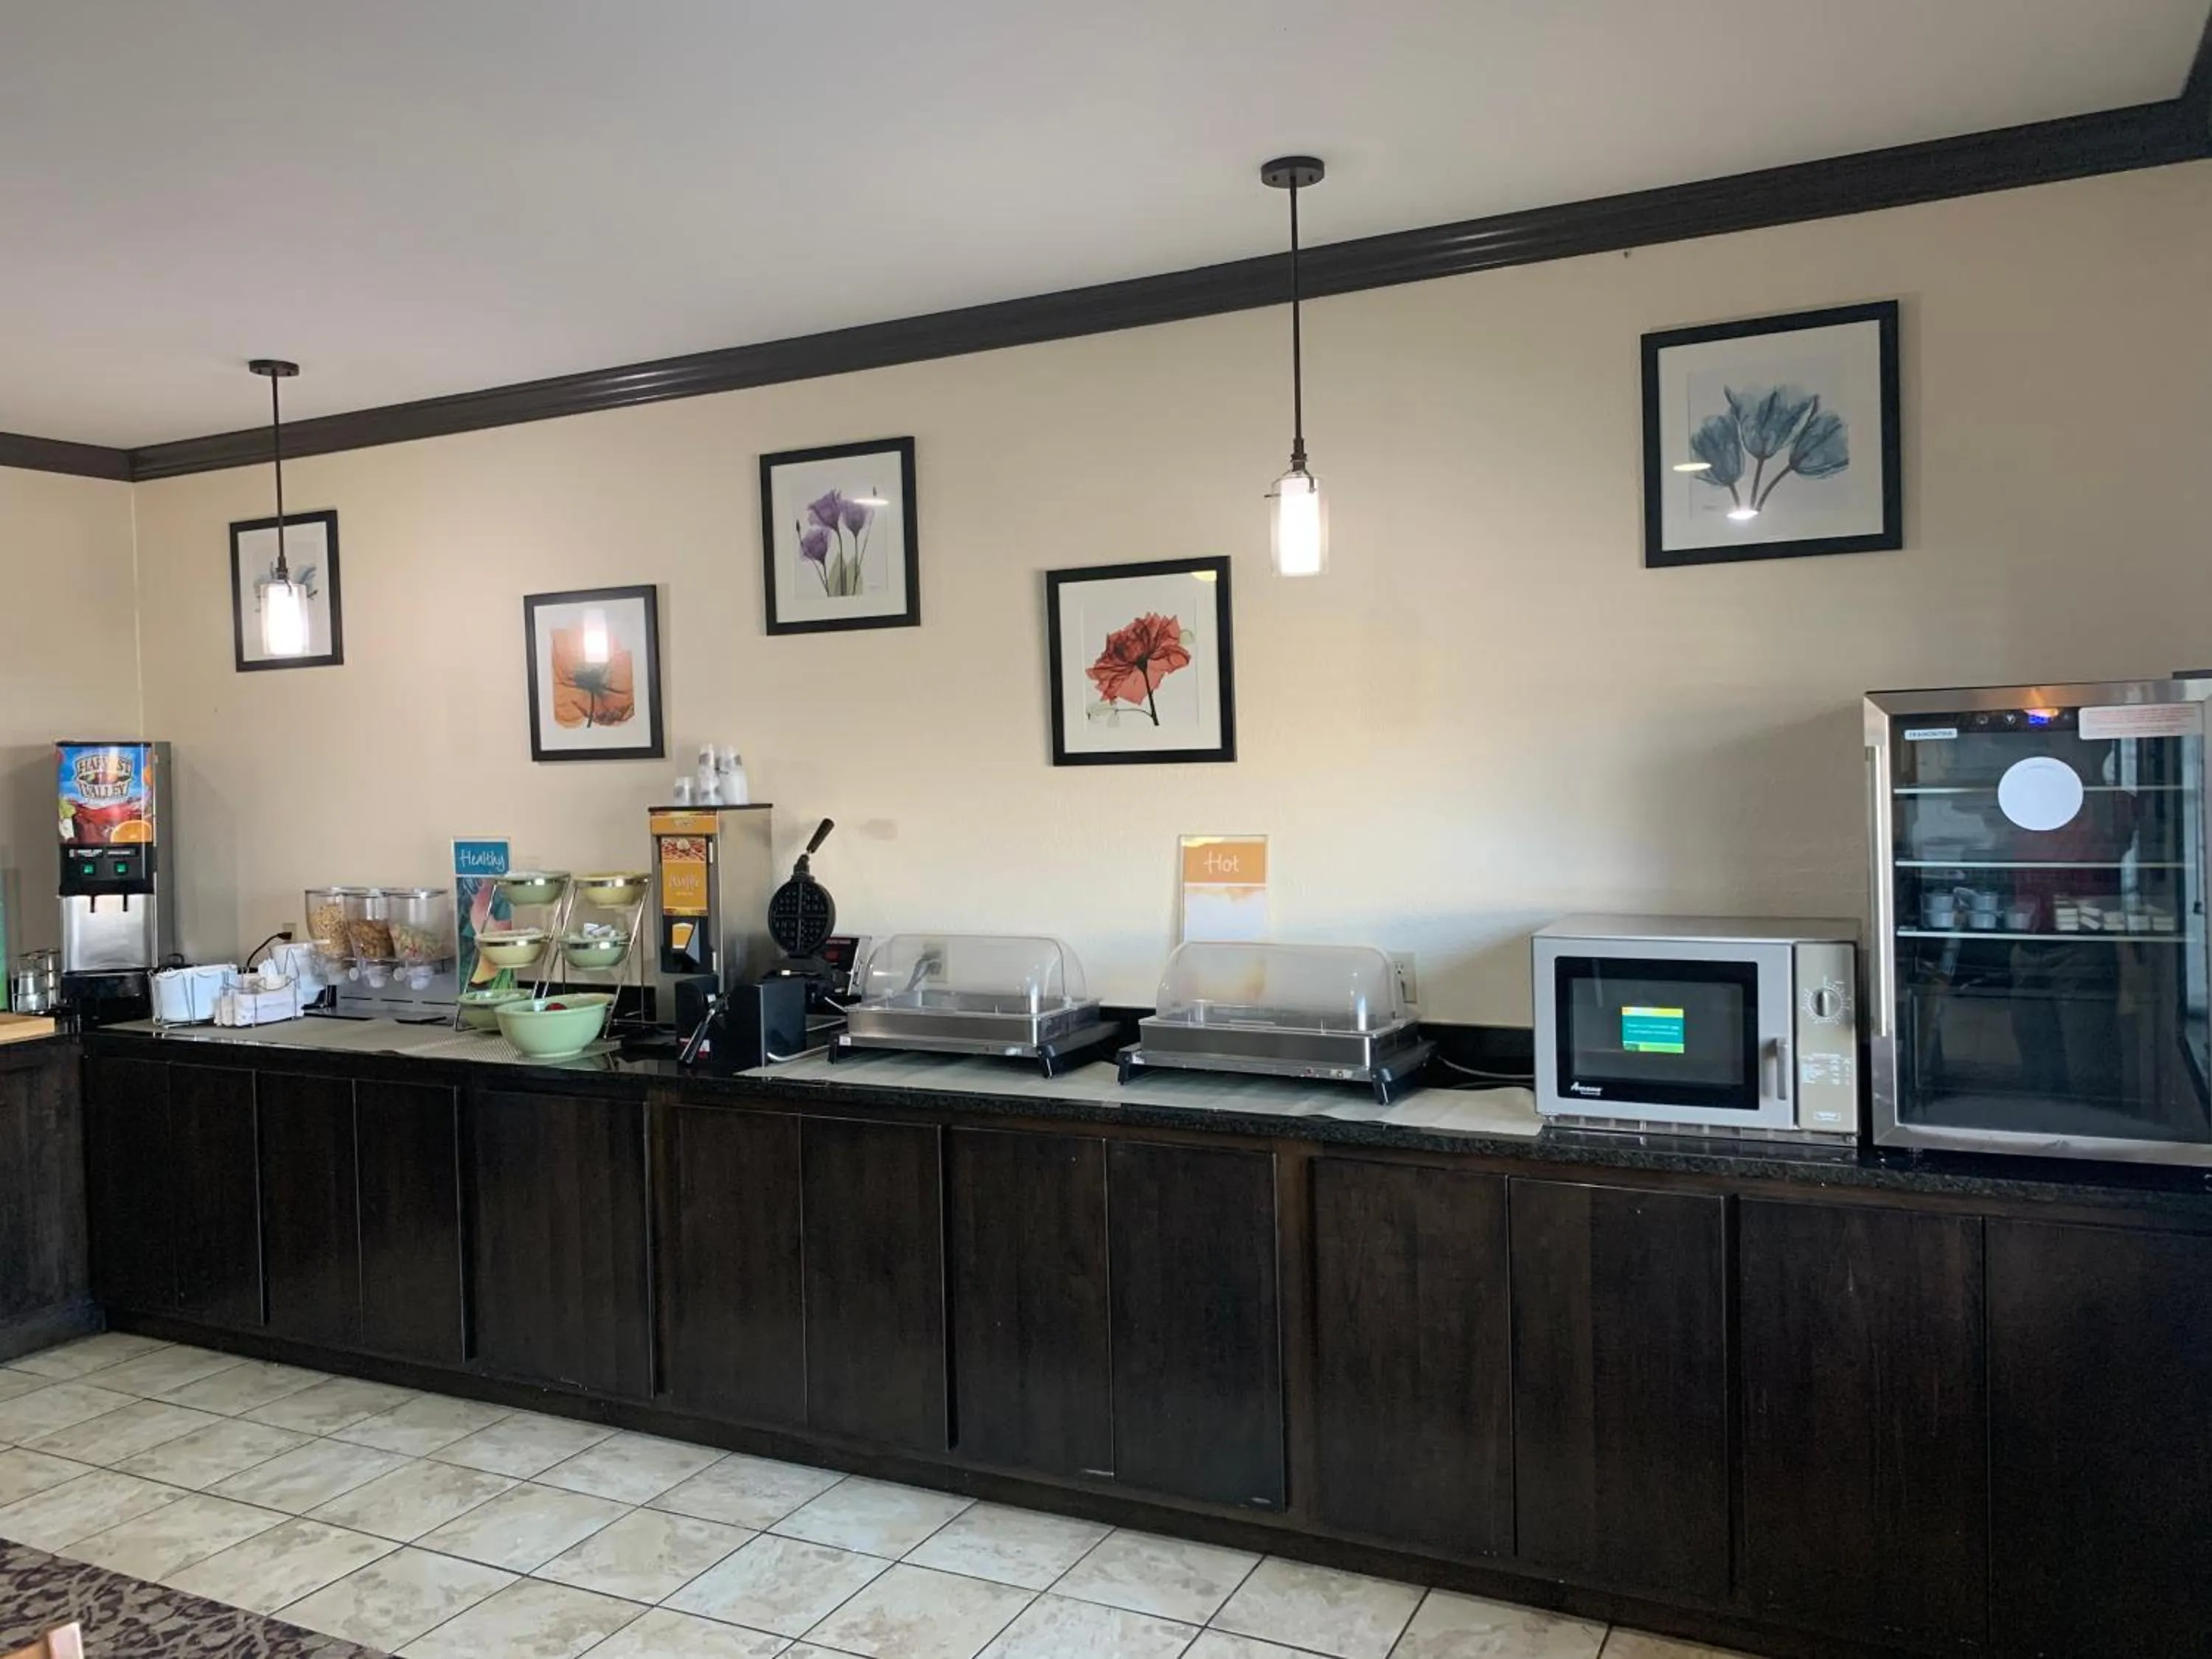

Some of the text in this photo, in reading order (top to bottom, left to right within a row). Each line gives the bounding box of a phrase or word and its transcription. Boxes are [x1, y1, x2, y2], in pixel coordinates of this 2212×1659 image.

[80, 782, 126, 799] VALLEY
[460, 849, 505, 872] Healthy
[1203, 849, 1239, 875] Hot
